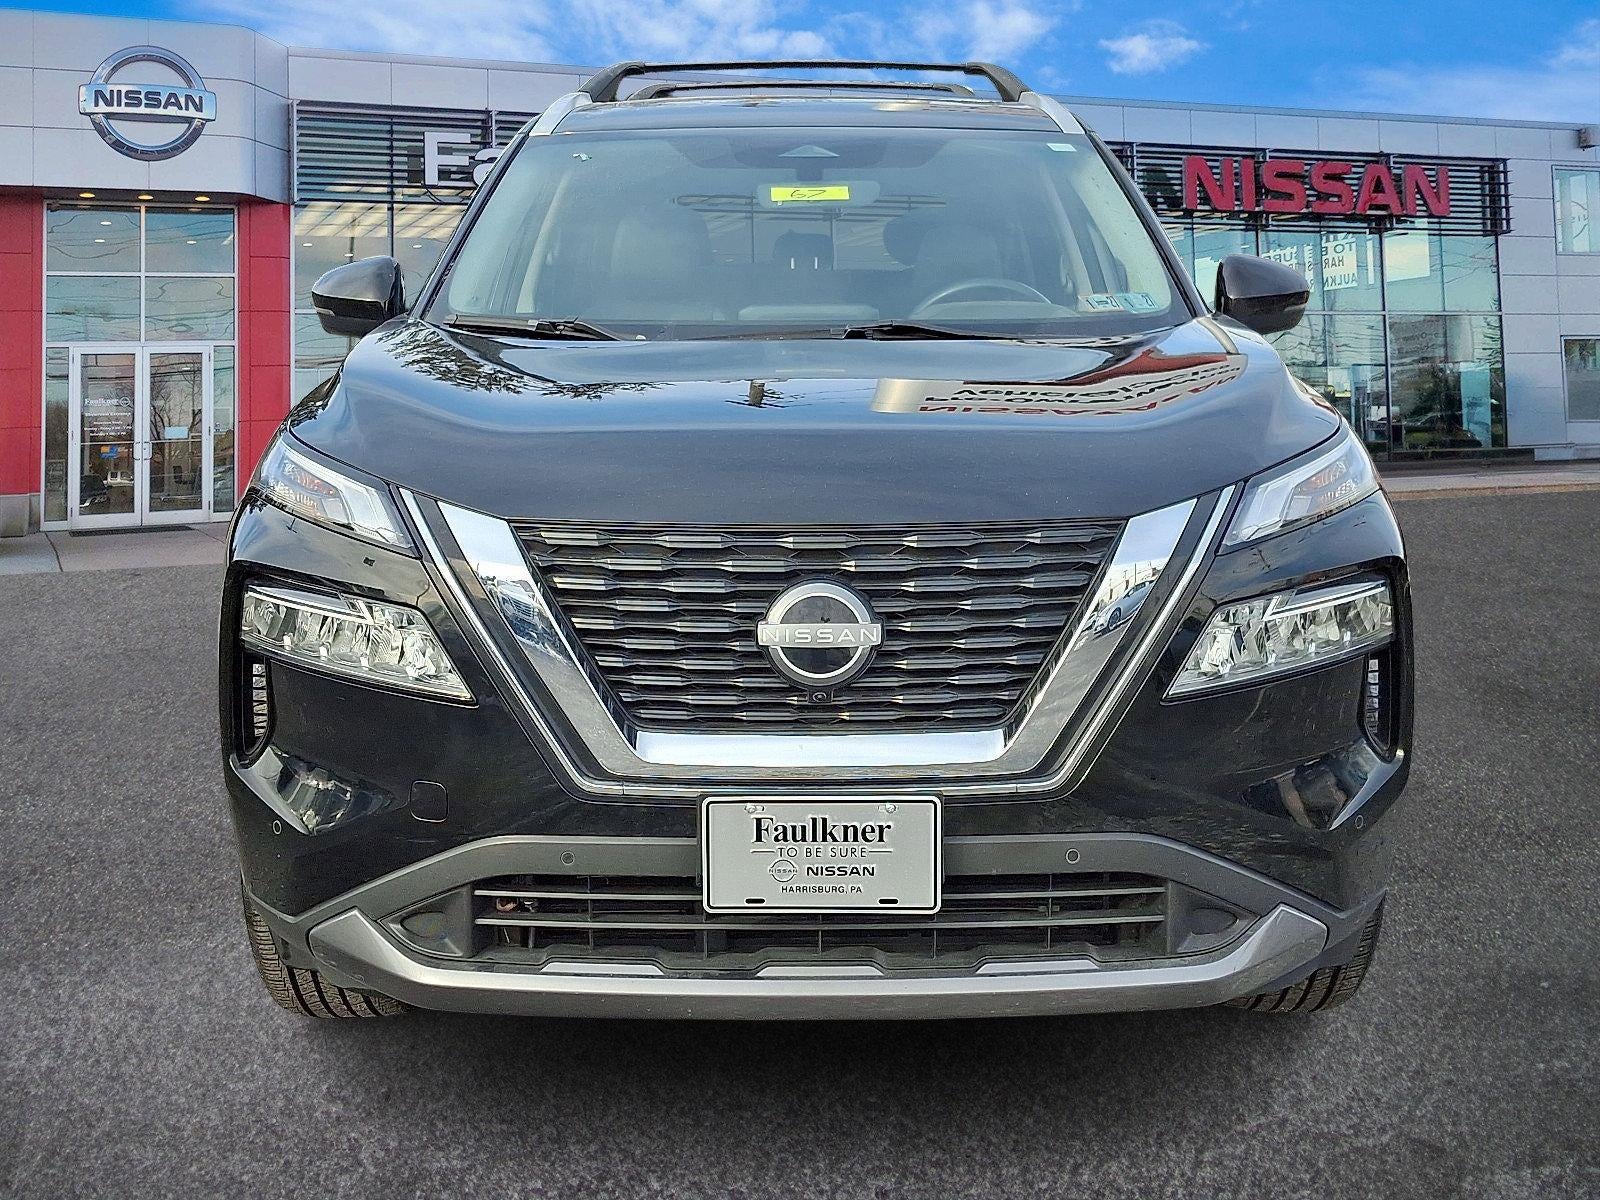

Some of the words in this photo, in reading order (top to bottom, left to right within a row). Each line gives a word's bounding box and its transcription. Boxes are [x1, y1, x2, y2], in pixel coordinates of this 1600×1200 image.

[93, 88, 204, 113] NISSAN
[1182, 154, 1451, 217] NISSAN
[762, 627, 878, 644] NISSAN
[751, 816, 892, 844] Faulkner
[777, 847, 798, 858] TO
[805, 847, 822, 858] BE
[830, 847, 867, 858] SURE
[806, 865, 876, 877] NISSAN
[781, 885, 848, 894] HARRISBURG,
[850, 885, 863, 894] PA
